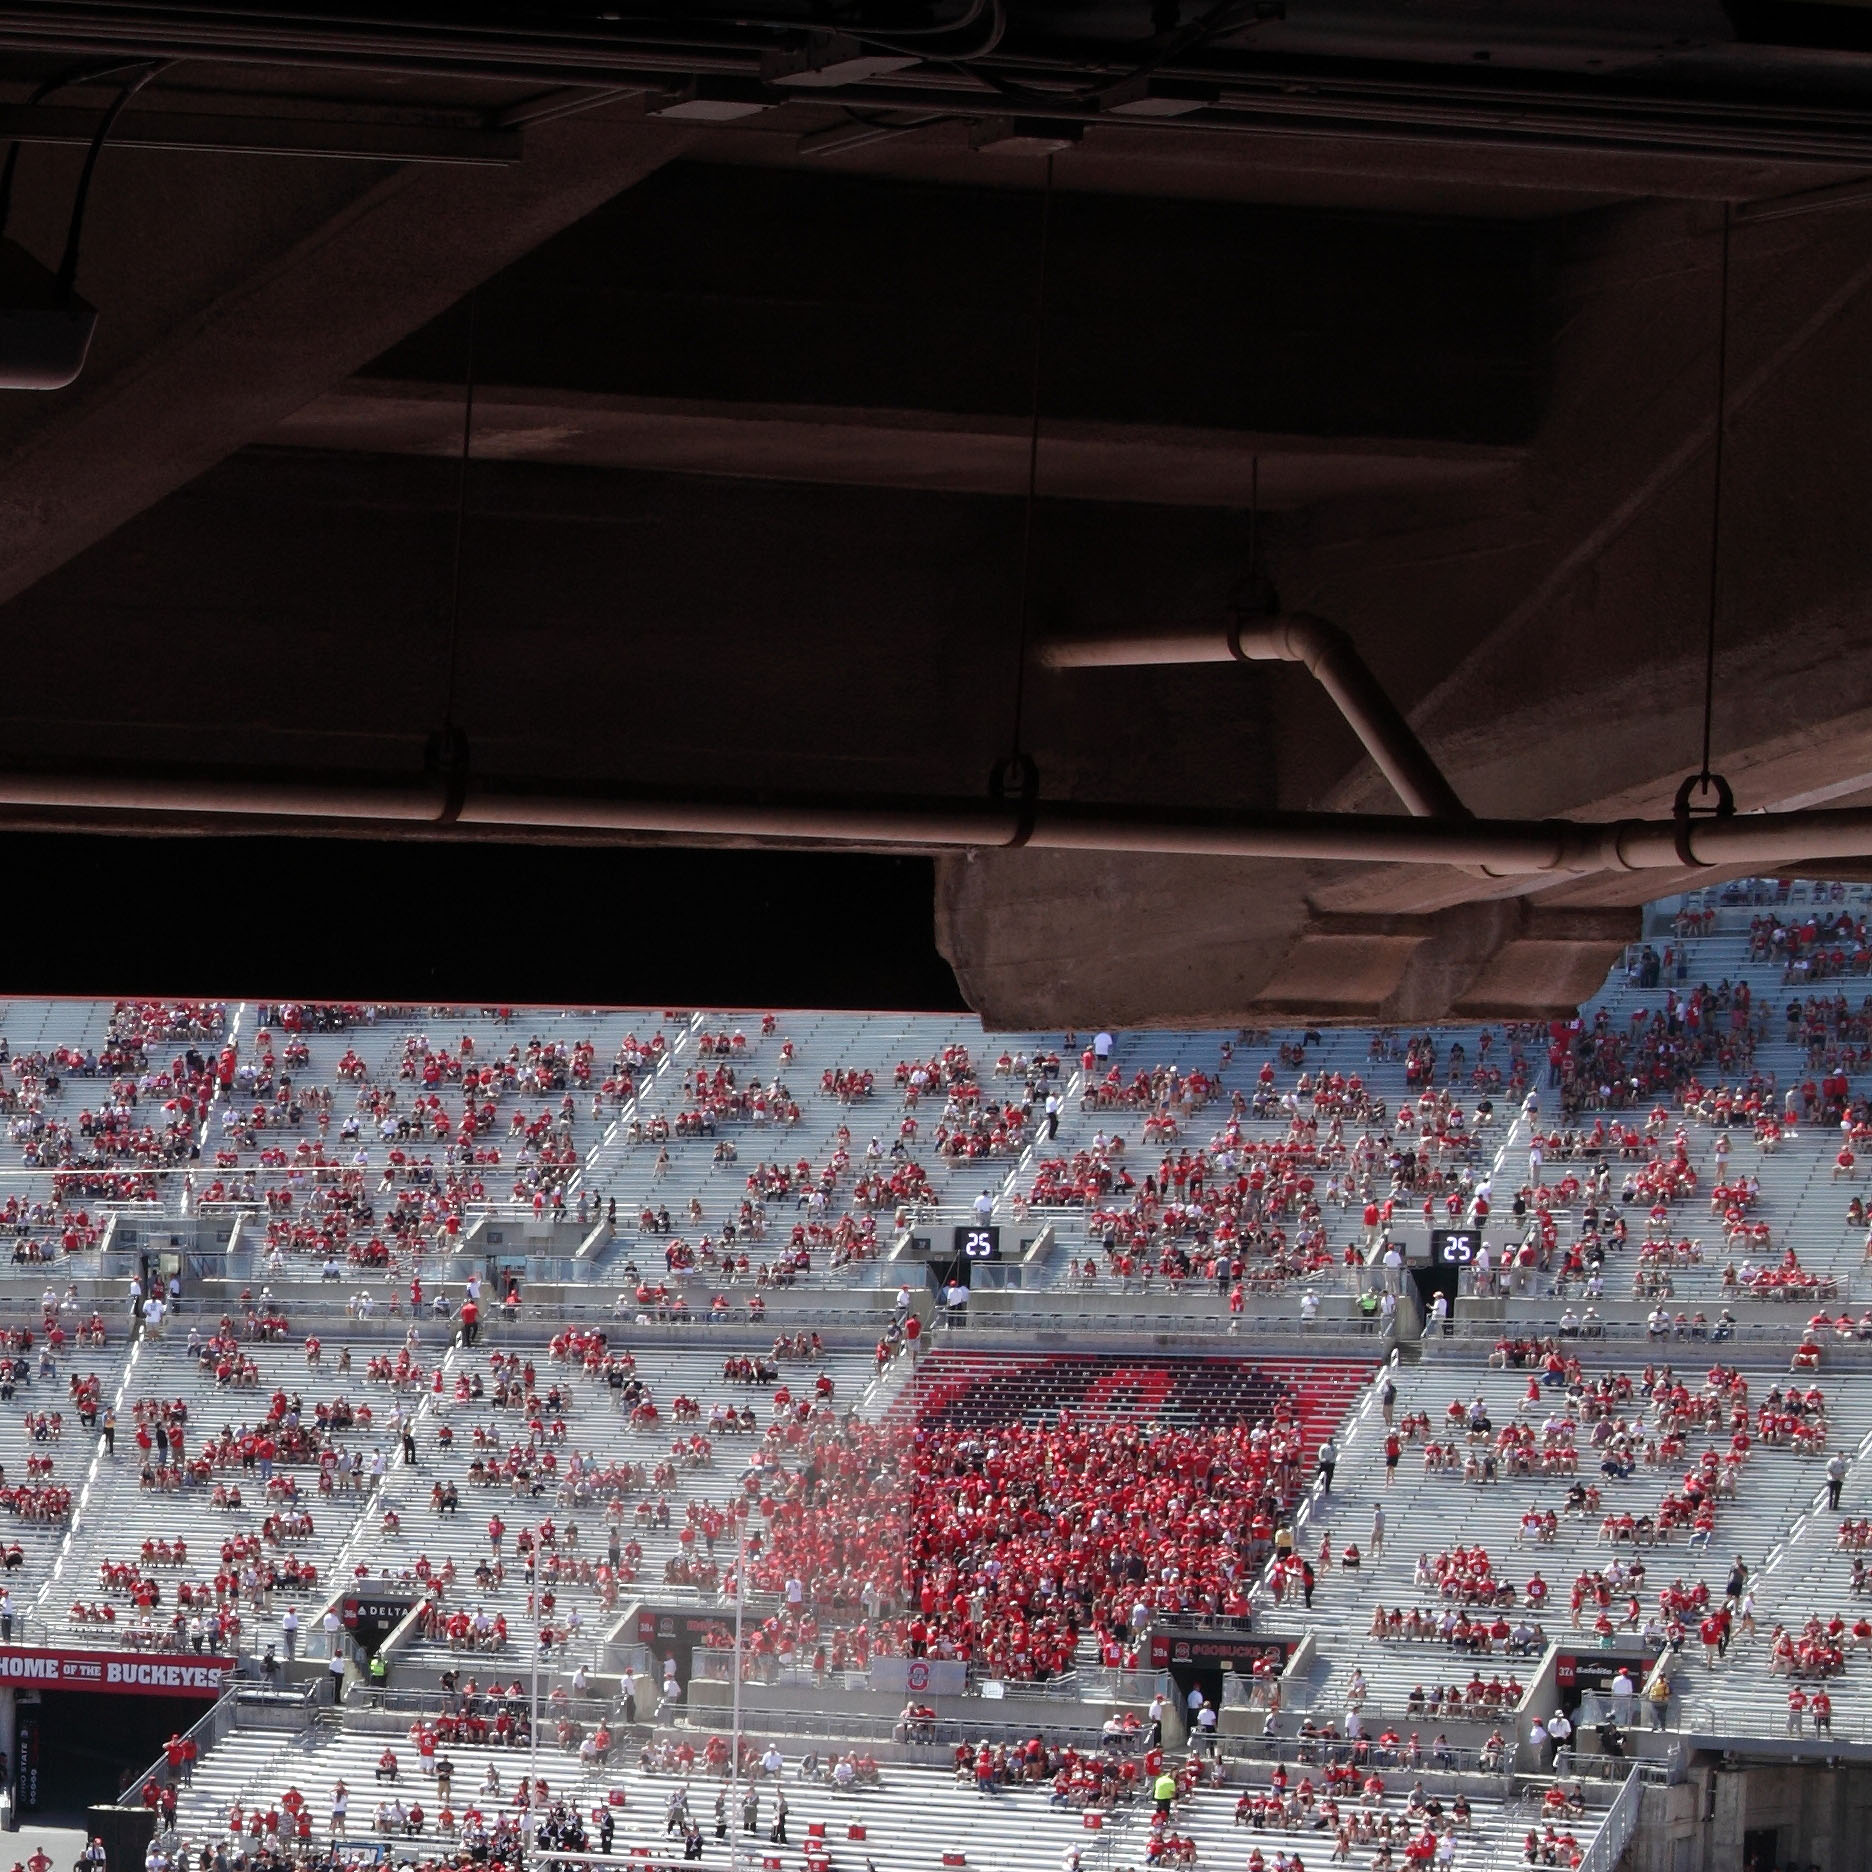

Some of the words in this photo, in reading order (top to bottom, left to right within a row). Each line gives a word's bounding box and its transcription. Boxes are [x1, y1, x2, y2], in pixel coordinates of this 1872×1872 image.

[965, 1233, 992, 1257] 25
[1442, 1236, 1472, 1263] 25
[369, 1606, 410, 1616] DELTA
[63, 1665, 77, 1677] OF
[79, 1664, 102, 1678] THE
[106, 1662, 222, 1688] BUCKEYES
